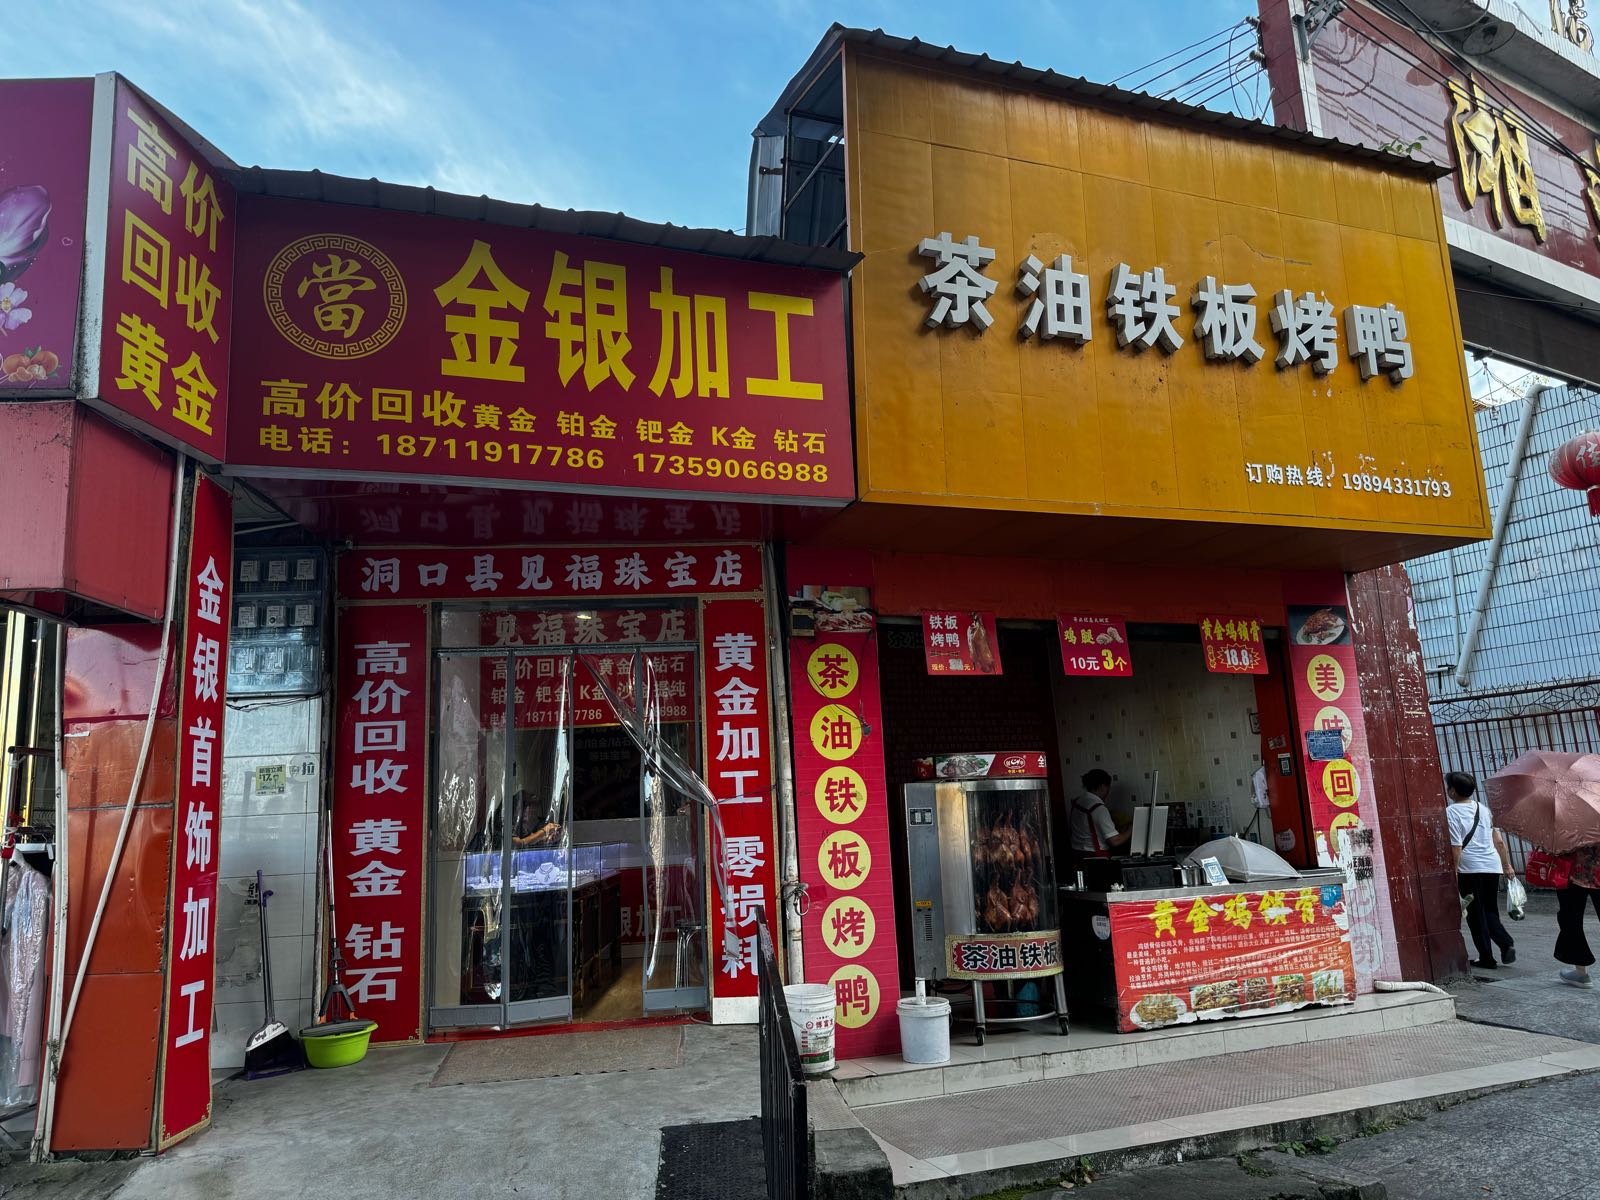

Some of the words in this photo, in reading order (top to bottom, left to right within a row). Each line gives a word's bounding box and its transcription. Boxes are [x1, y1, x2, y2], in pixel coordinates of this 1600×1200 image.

[126, 106, 225, 253] 高价
[121, 208, 222, 345] 回收
[297, 253, 377, 339] 當
[917, 231, 1414, 385] 茶油铁板烤鸭
[433, 238, 824, 401] 金银加工
[115, 311, 218, 437] 黄金
[259, 424, 351, 455] 电话：
[376, 433, 606, 470] 18711917786
[632, 452, 829, 484] 17359066988
[260, 379, 467, 429] 高价回收
[472, 403, 536, 433] 黄金
[556, 410, 618, 441] 铂金
[636, 417, 694, 447] 钯金
[712, 425, 757, 451] K金
[774, 429, 827, 455] 钻石
[1245, 461, 1333, 489] 订购热线：
[1341, 472, 1452, 499] 19894331793
[360, 549, 744, 594] 洞口县见福珠宝店
[494, 609, 687, 646] 见福珠宝店
[929, 614, 959, 630] 铁板
[930, 632, 960, 648] 烤鸭
[599, 658, 632, 677] 黄金
[652, 655, 686, 673] 钻石
[350, 640, 411, 795] 高价回收
[712, 632, 763, 805] 黄金加工
[174, 556, 226, 1049] 金银首饰加工
[815, 653, 870, 1017] 茶油铁板烤鸭
[347, 818, 407, 898] 黄金
[1147, 886, 1319, 939] 黄金鸡锁骨
[345, 921, 404, 1003] 钻石
[961, 941, 1059, 970] 茶油铁板
